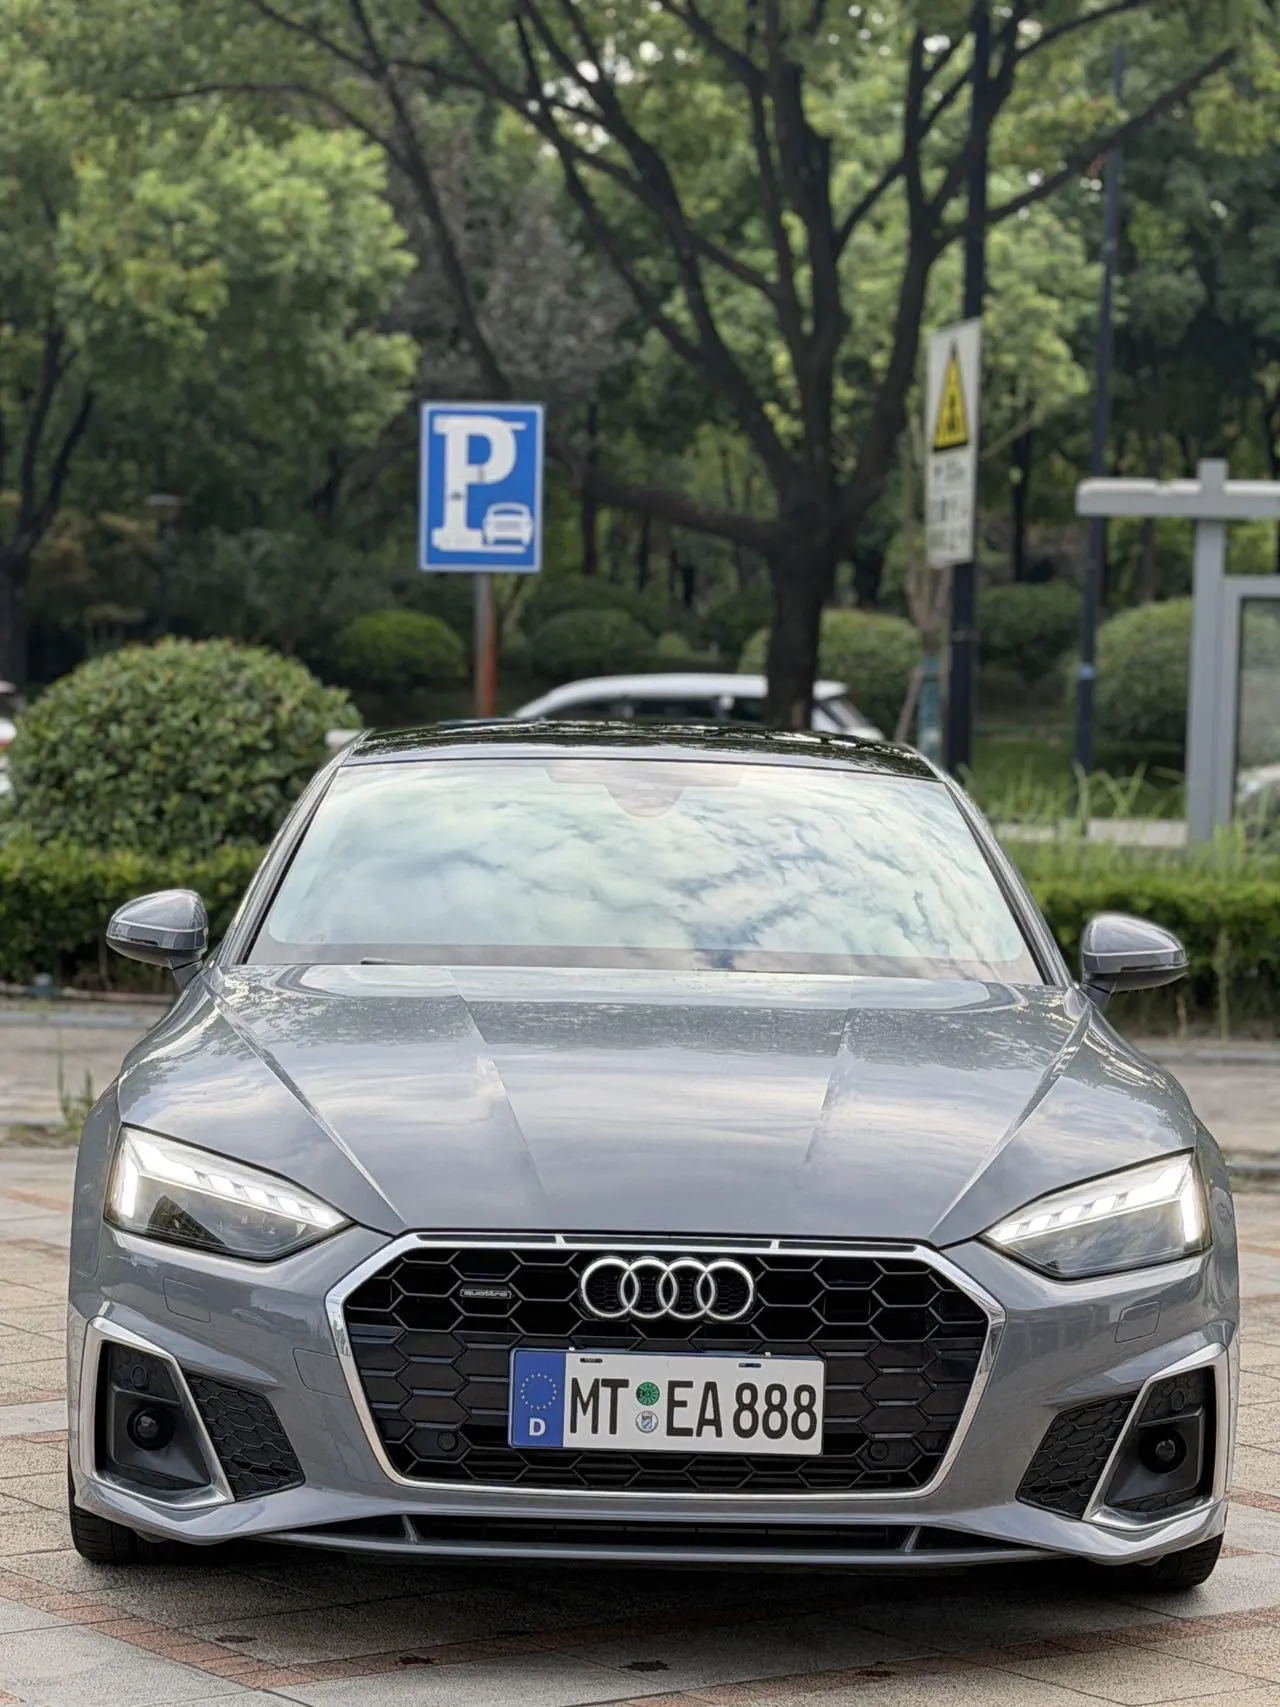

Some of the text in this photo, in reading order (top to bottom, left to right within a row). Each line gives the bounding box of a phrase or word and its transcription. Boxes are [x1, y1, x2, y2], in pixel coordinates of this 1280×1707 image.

[432, 415, 522, 552] P
[528, 1417, 546, 1437] D
[569, 1377, 818, 1440] MT EA 888
